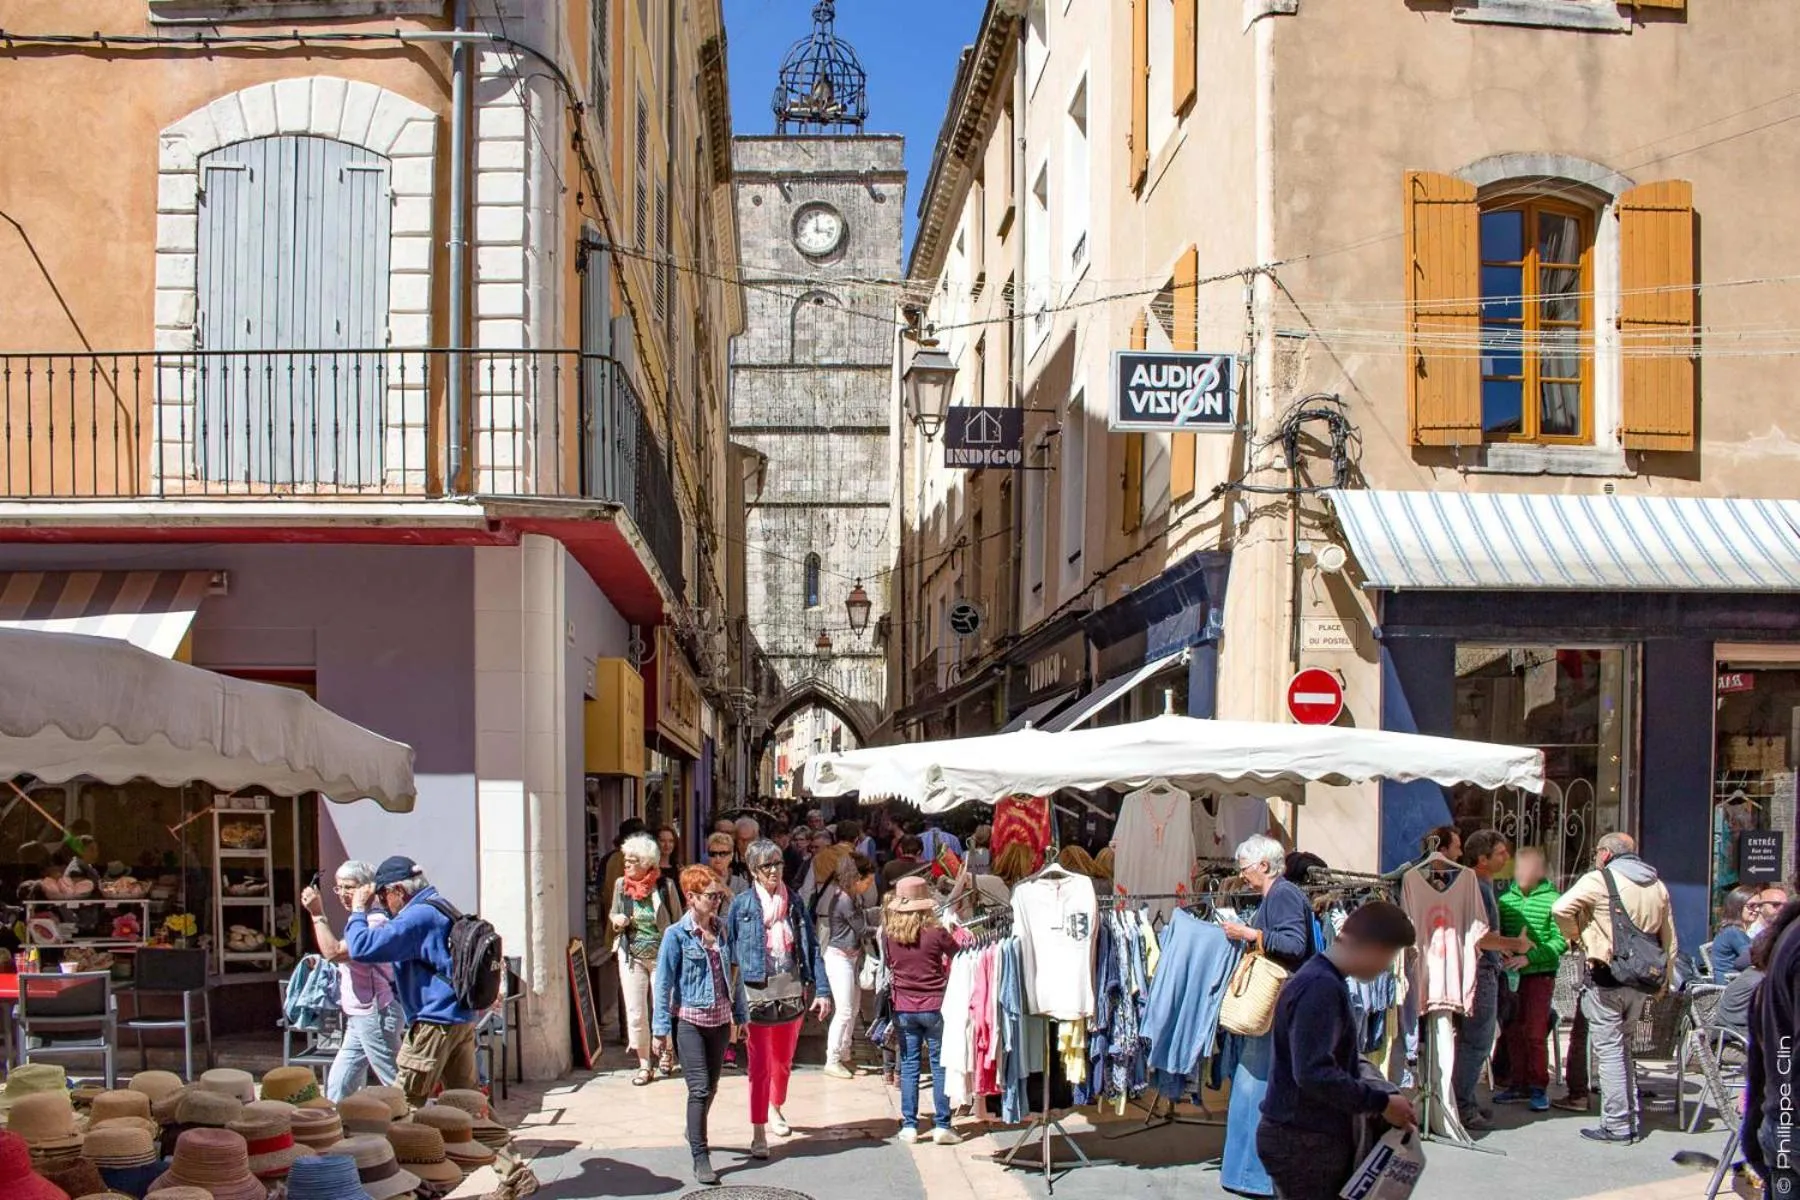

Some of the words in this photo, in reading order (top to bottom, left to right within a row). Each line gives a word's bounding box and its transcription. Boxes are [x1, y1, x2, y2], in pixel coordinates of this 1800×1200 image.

[1129, 363, 1220, 391] AUDIO
[1128, 389, 1223, 417] VISION
[946, 448, 1021, 465] INDIGO
[1030, 652, 1060, 694] INDIGO
[1748, 837, 1776, 846] ENTRÉE
